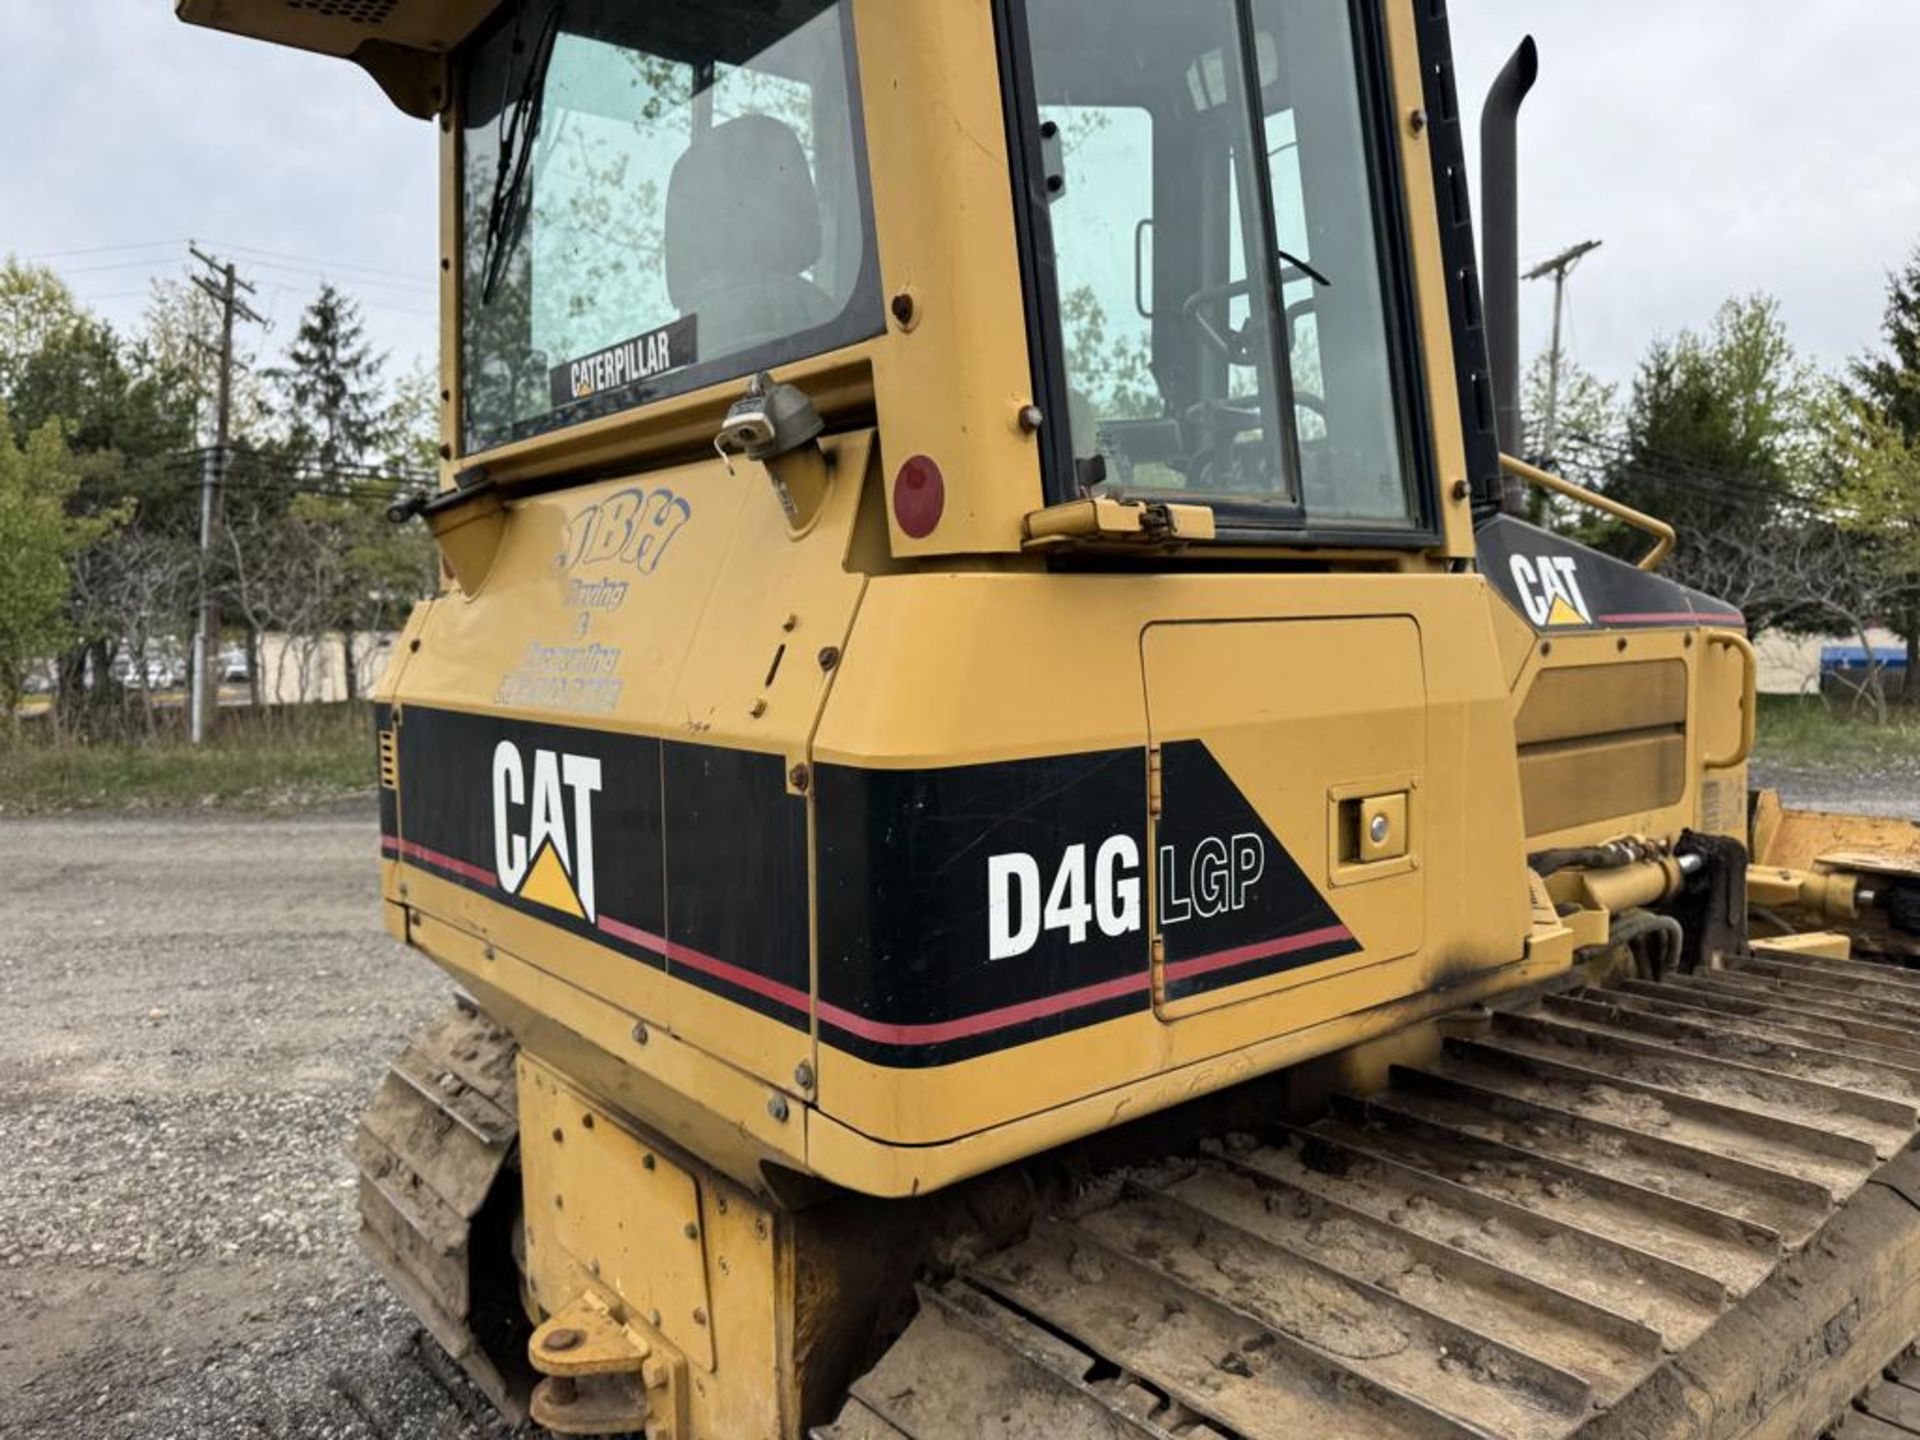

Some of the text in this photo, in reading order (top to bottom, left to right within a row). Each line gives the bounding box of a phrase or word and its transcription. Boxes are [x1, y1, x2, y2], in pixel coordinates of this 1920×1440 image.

[571, 331, 670, 398] CATERPILLAR
[1509, 553, 1593, 626] CAT
[492, 739, 603, 925] CAT
[988, 832, 1265, 961] D4G LGP
